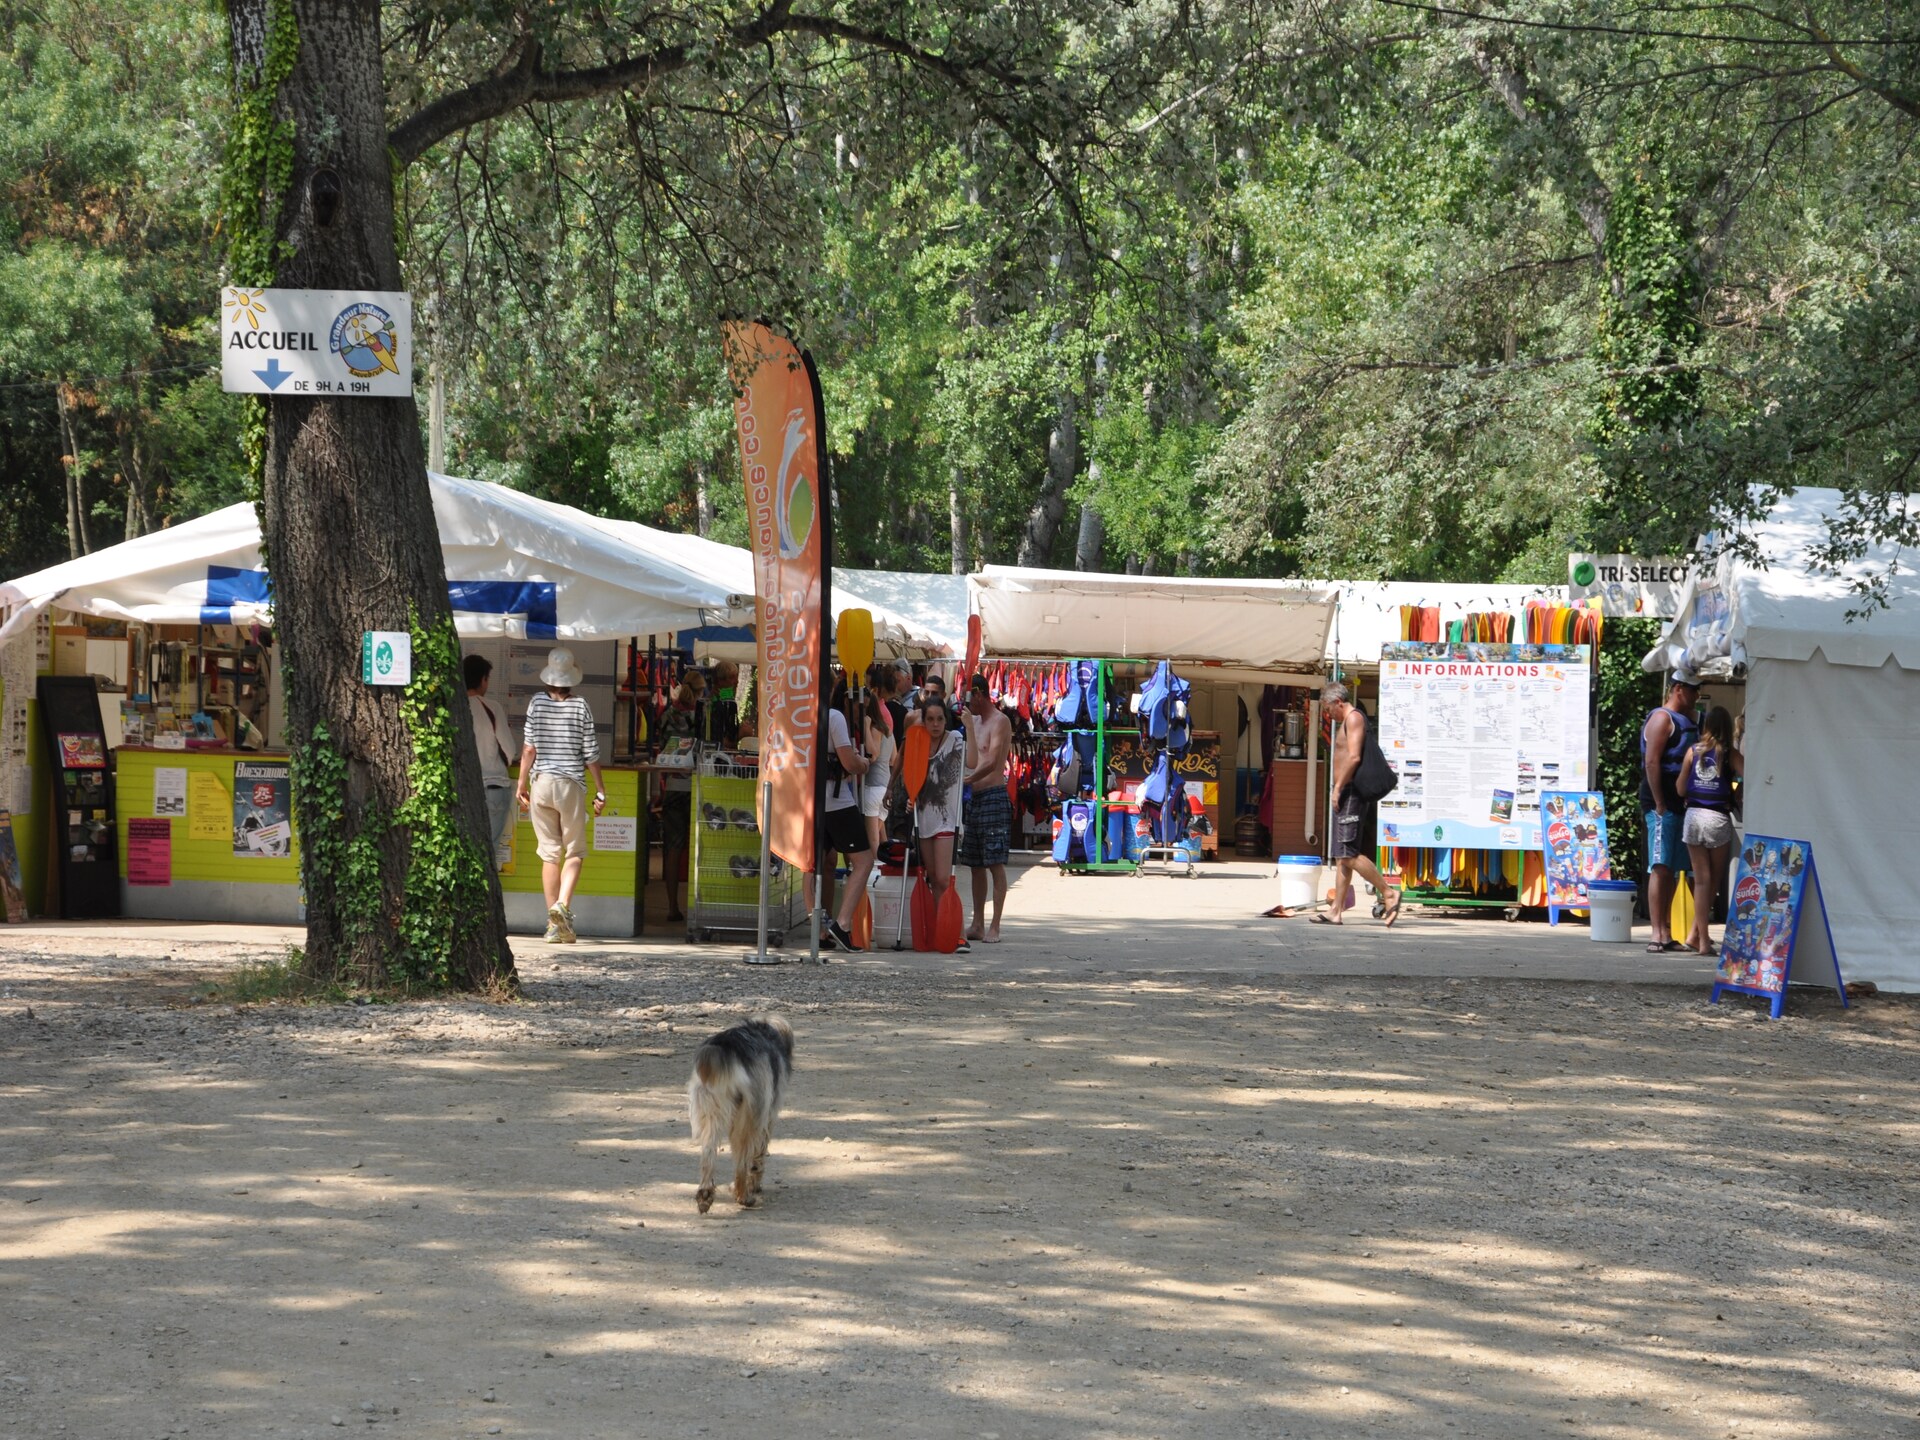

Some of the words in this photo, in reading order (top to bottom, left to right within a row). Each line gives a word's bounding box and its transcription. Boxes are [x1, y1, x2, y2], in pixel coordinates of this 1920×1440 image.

[330, 306, 358, 351] Grandeur
[358, 303, 387, 321] Nature
[228, 330, 319, 352] ACCUEIL
[294, 380, 309, 391] DE
[316, 381, 331, 392] 9H
[337, 382, 345, 392] A
[350, 382, 370, 393] 19H
[1404, 664, 1539, 677] INFORMATIONS
